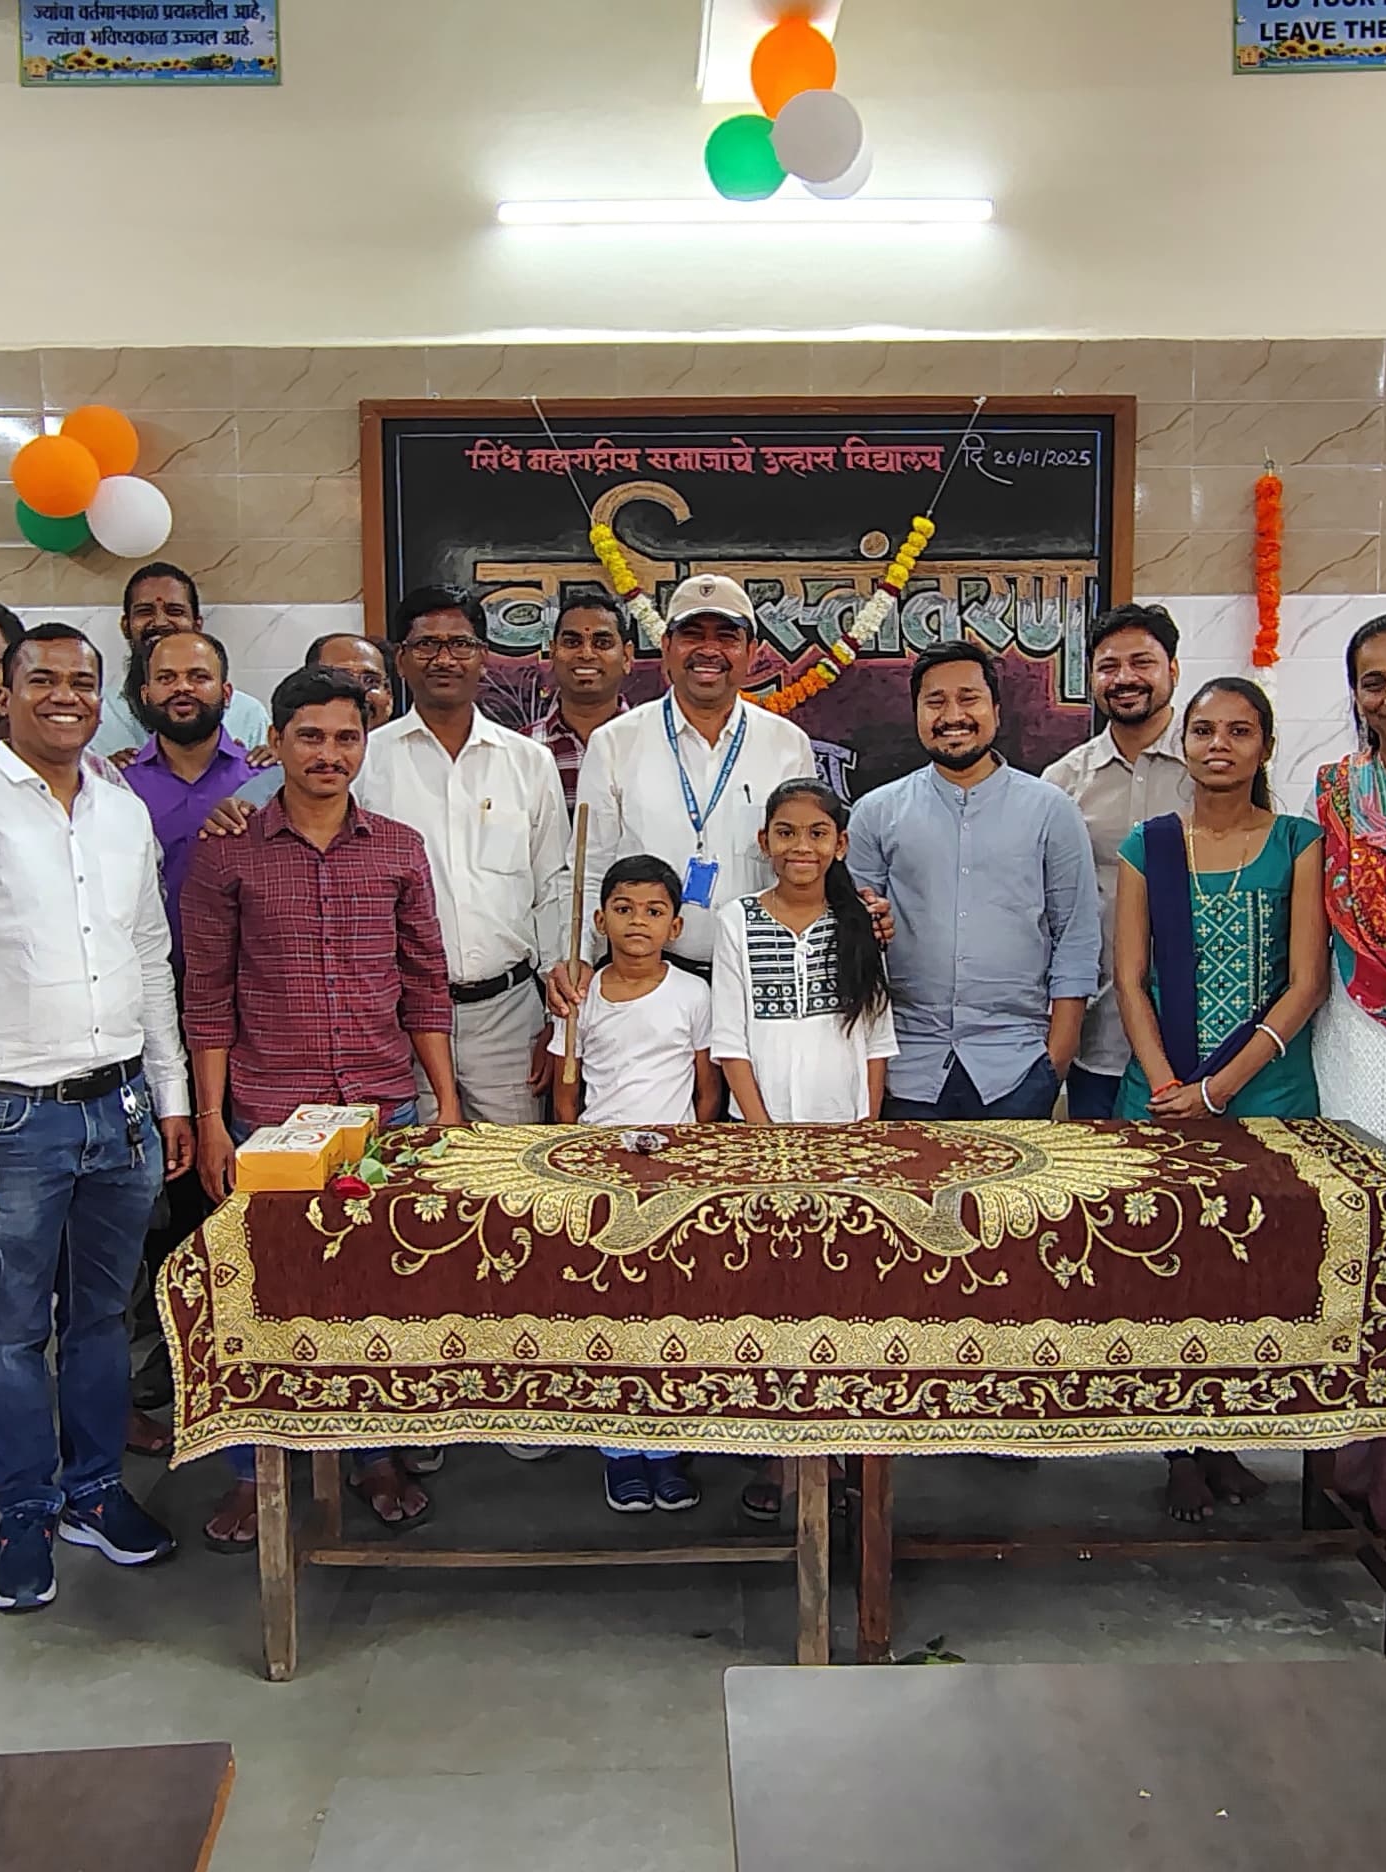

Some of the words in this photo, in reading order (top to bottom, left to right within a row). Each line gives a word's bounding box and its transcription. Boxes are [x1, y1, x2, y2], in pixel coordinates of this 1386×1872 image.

[1260, 21, 1336, 41] LEAVE
[644, 437, 756, 473] समाजाचे
[759, 446, 838, 477] उल्हास
[841, 436, 946, 474] विद्यालय
[993, 447, 1092, 469] 26/01/2025
